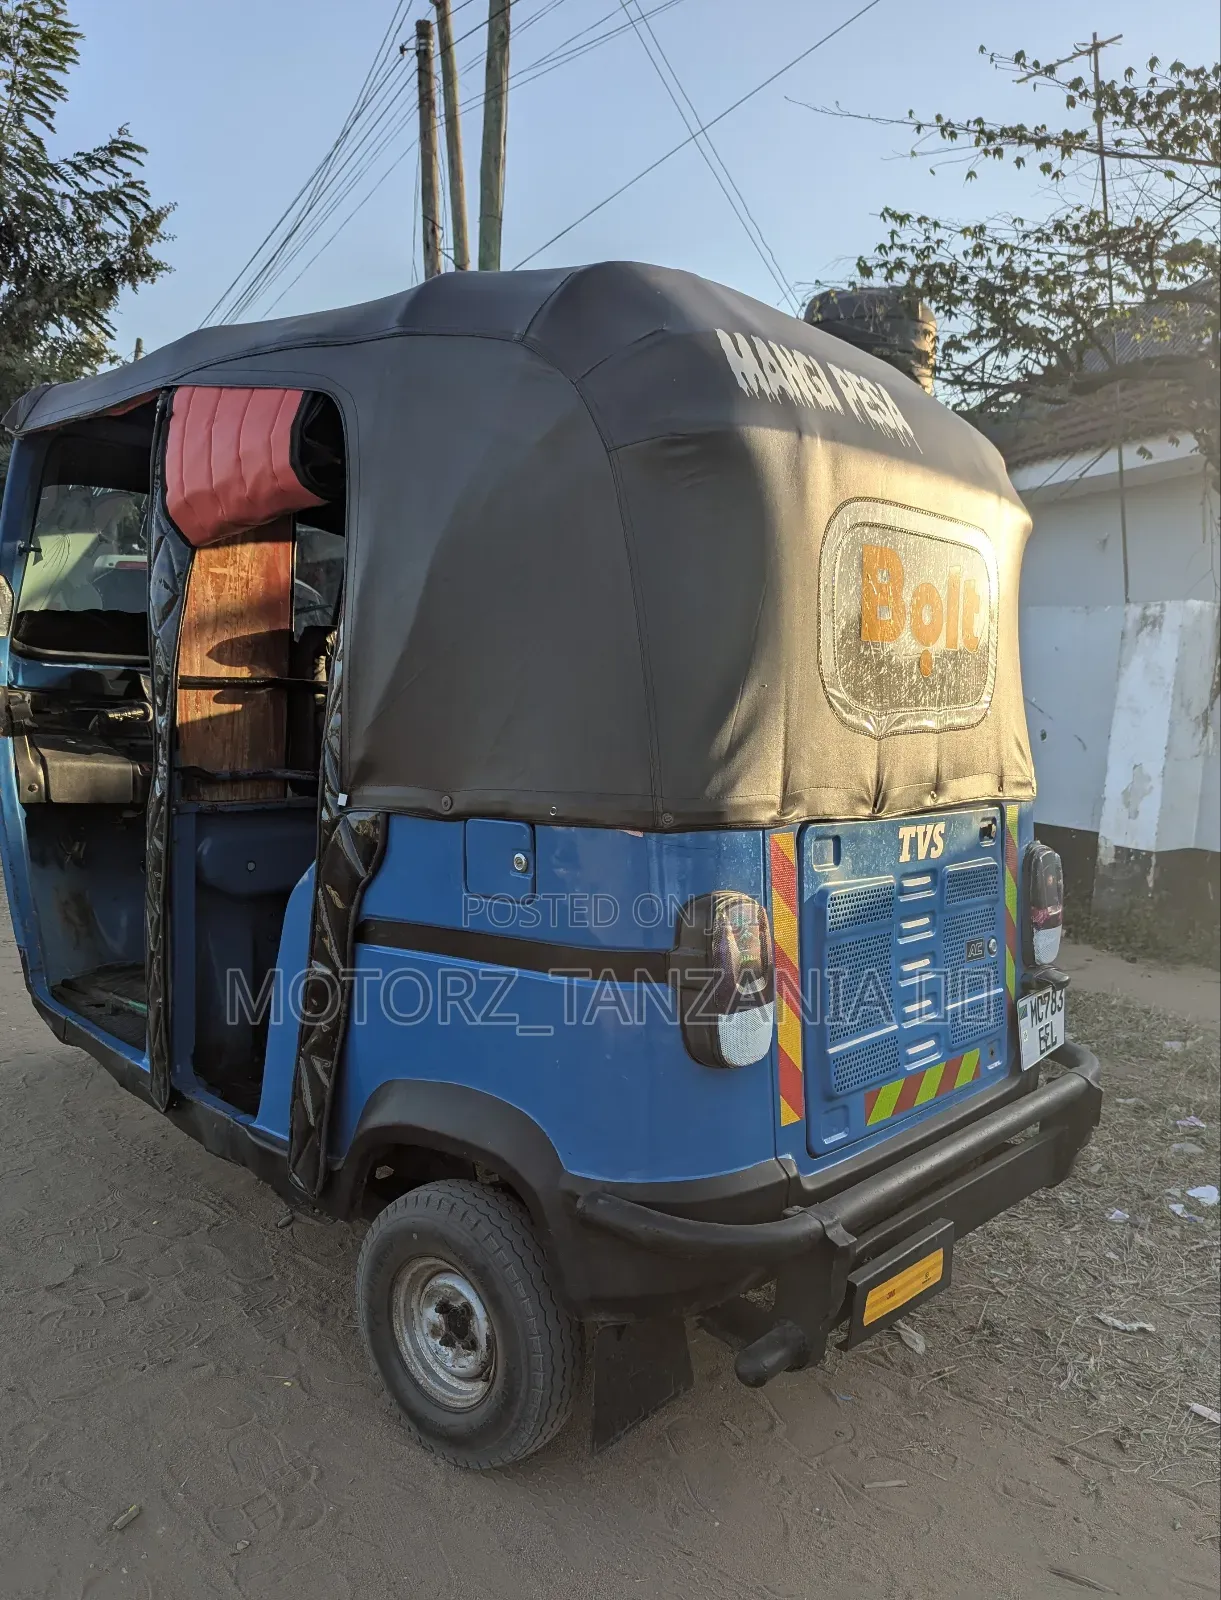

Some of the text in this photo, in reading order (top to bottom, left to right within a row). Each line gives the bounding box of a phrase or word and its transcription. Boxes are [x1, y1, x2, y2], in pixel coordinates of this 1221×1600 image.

[714, 328, 923, 454] MANGI PESA
[860, 544, 980, 654] Bolt
[898, 822, 946, 863] TVS
[1030, 988, 1064, 1028] MC783
[1039, 1020, 1058, 1054] EEL
